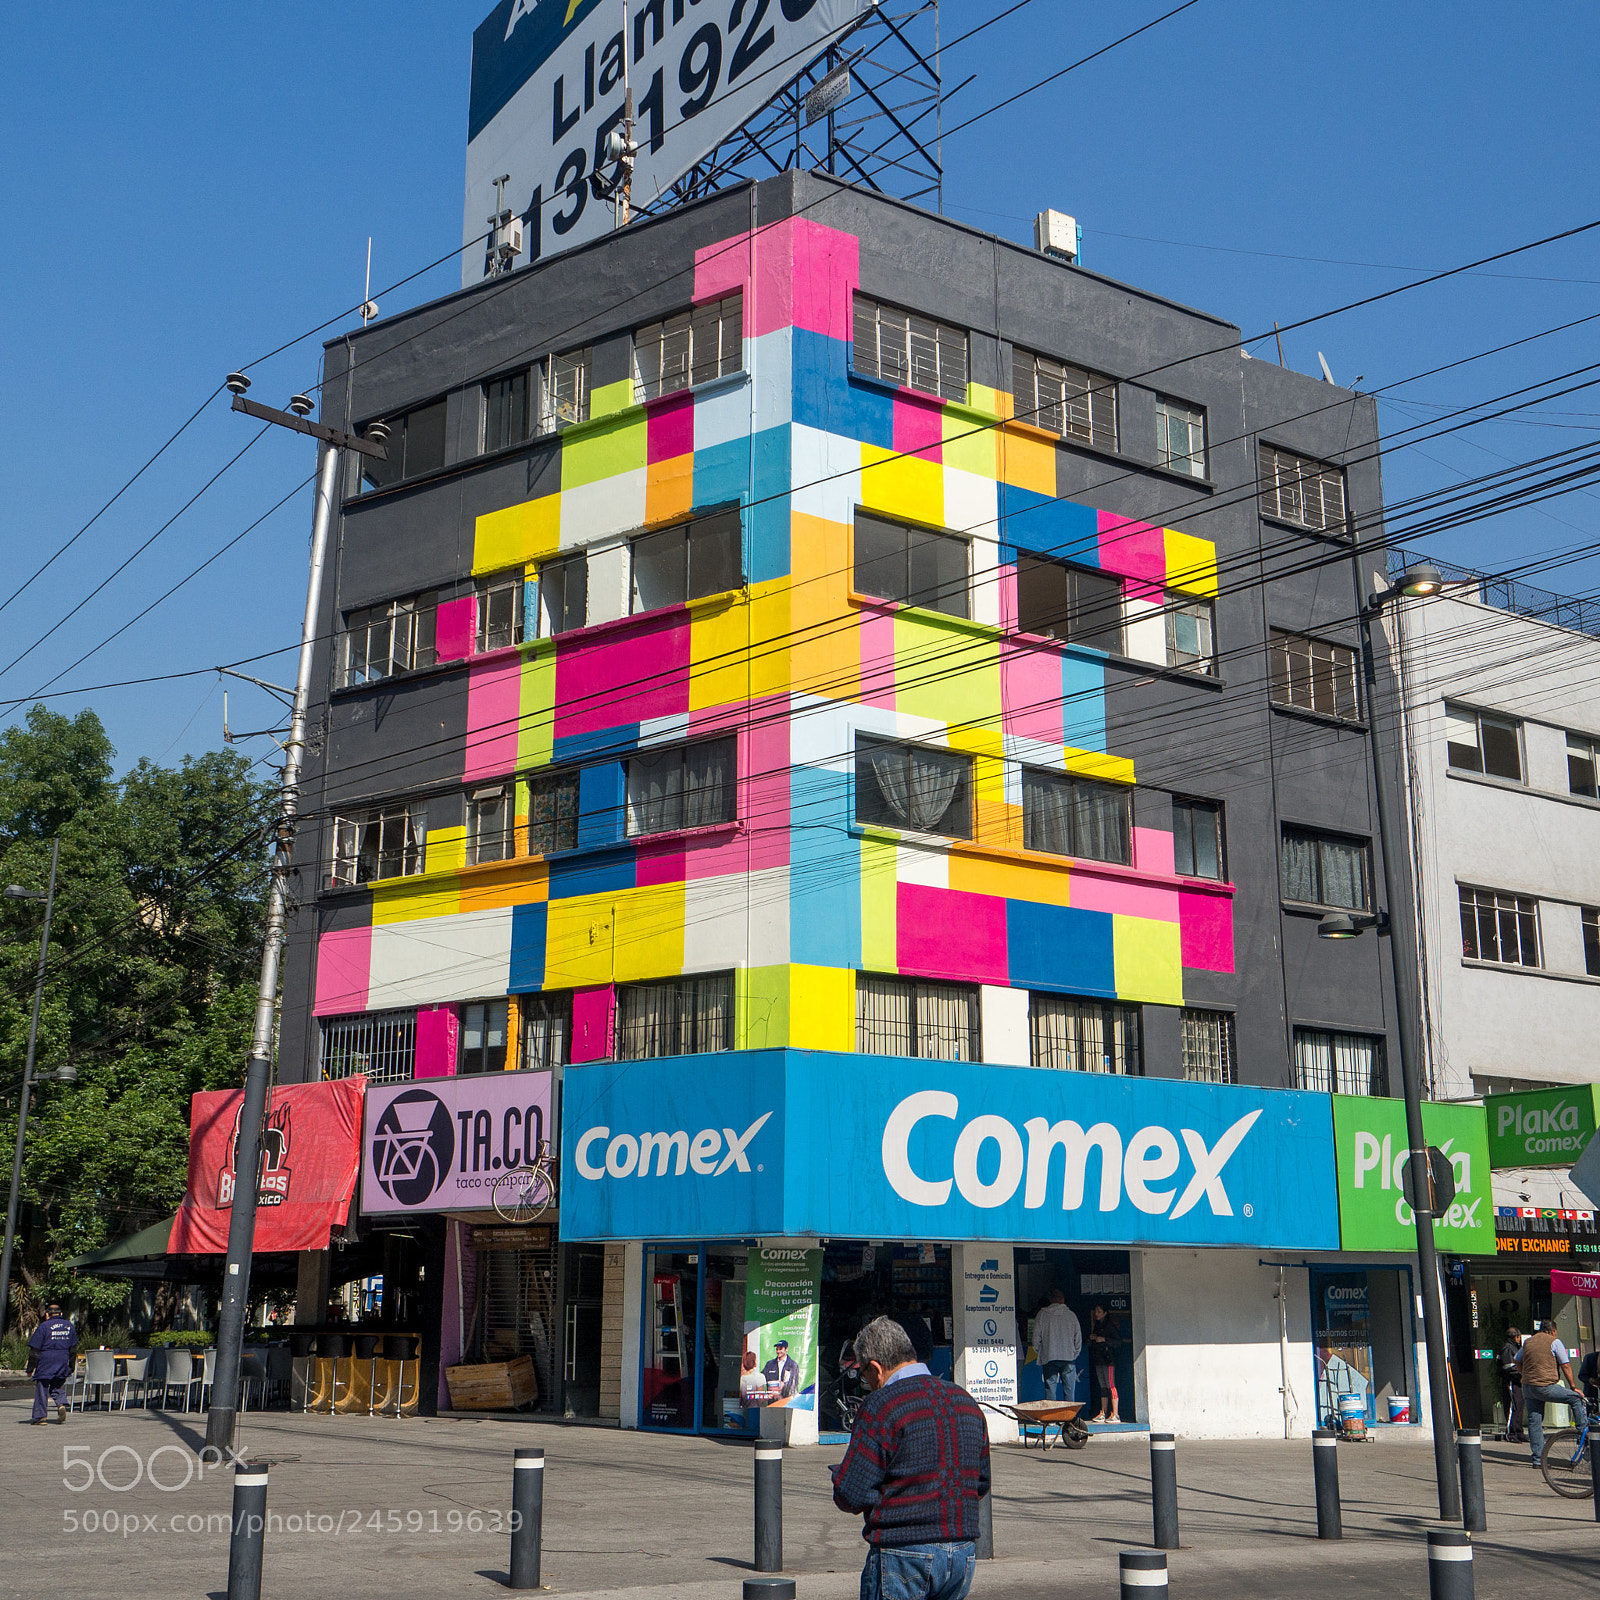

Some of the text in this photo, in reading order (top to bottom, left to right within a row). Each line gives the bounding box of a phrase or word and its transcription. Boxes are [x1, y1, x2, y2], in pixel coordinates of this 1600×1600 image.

[553, 0, 703, 144] Llam
[1497, 1099, 1579, 1137] Plaka
[457, 1105, 544, 1172] TA.CO
[575, 1110, 773, 1181] Comex
[882, 1090, 1263, 1219] Comex
[456, 1177, 482, 1189] taco
[1531, 1218, 1549, 1232] TARA
[1572, 1220, 1581, 1233] DE
[1495, 1238, 1571, 1252] ONEY EXCHANGE
[608, 1255, 619, 1266] 74
[760, 1248, 809, 1260] Comex
[1572, 1276, 1598, 1289] CDMX
[771, 1289, 800, 1297] puerta
[1328, 1285, 1368, 1299] Comex
[991, 1305, 1014, 1314] Tarjetas
[1110, 1298, 1127, 1309] caja
[789, 1312, 808, 1320] grati
